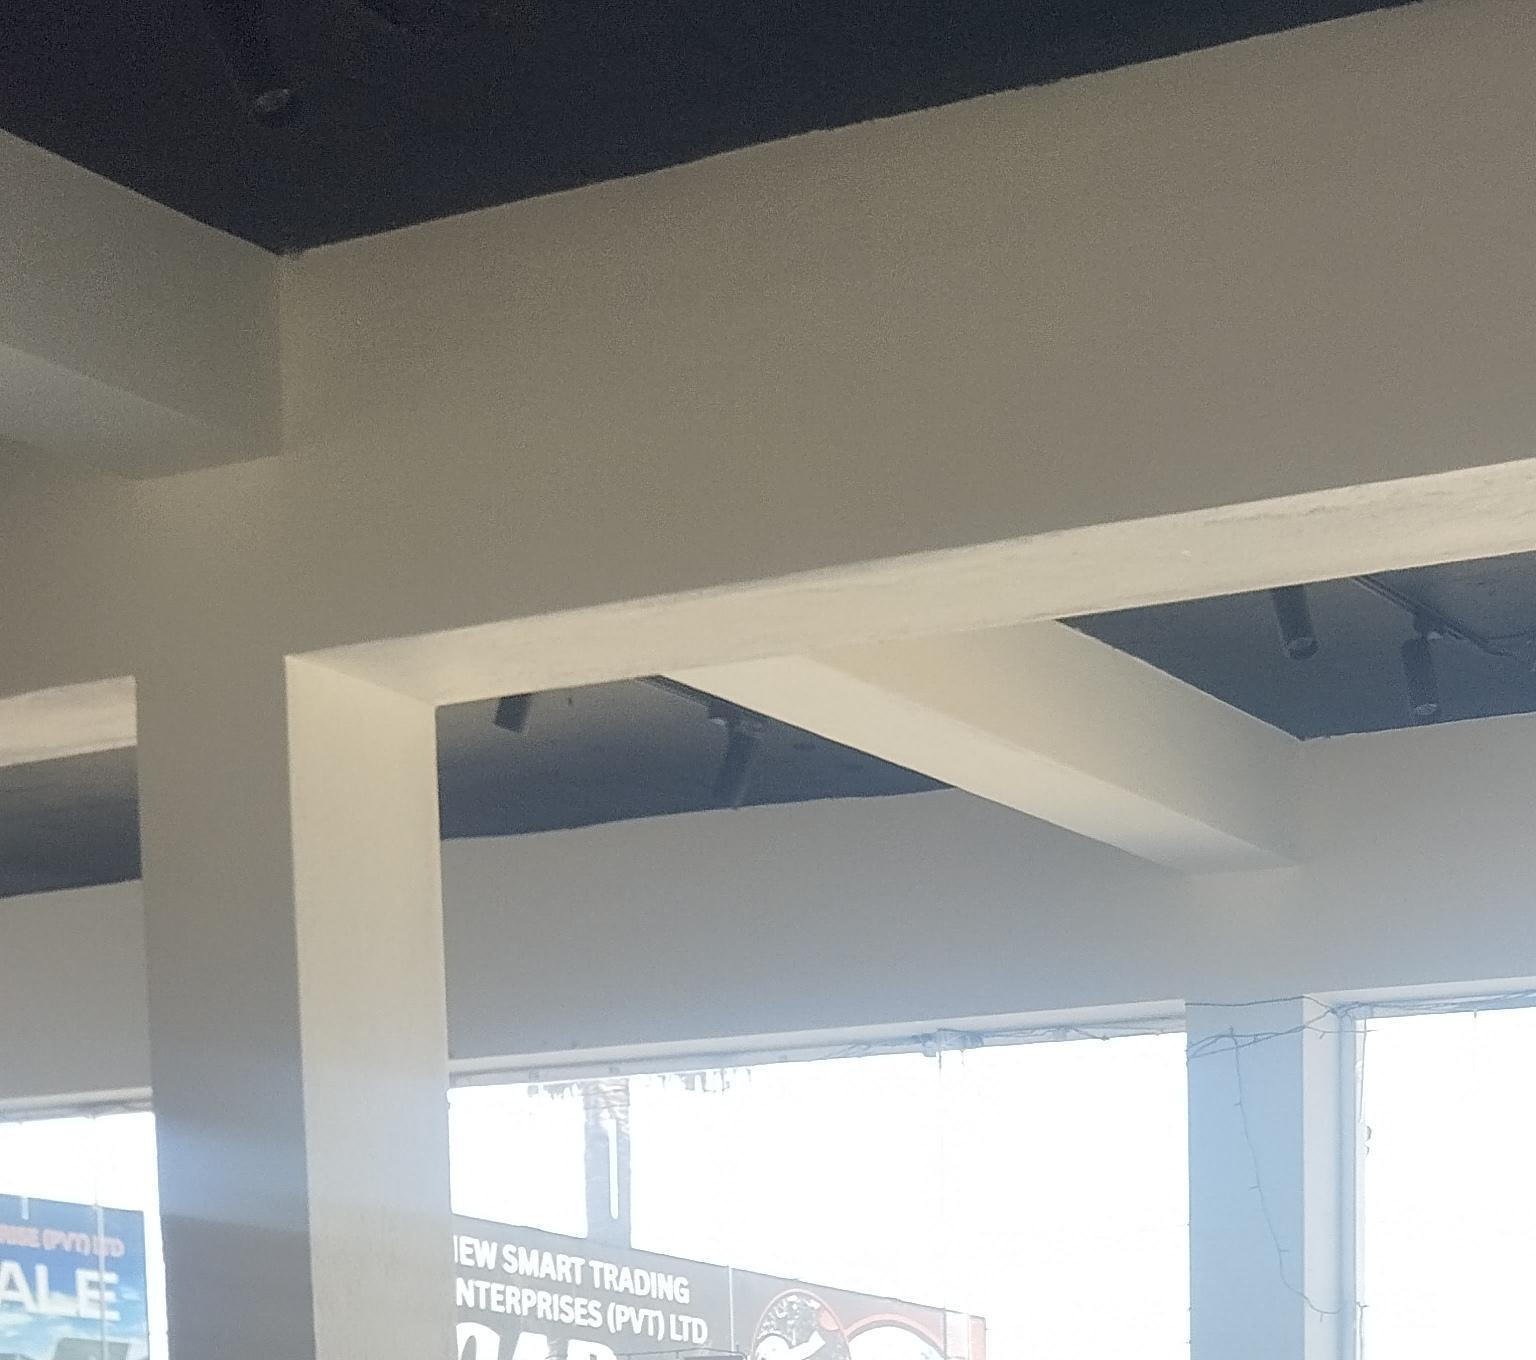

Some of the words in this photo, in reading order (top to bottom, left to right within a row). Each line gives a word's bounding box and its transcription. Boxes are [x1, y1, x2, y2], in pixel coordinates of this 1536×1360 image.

[0, 1260, 121, 1321] ALE
[502, 1244, 585, 1286] SMART
[589, 1260, 690, 1304] TRADING
[456, 1278, 603, 1328] NTERPRISES
[607, 1302, 665, 1341] (PVT)
[670, 1316, 708, 1343] LTD
